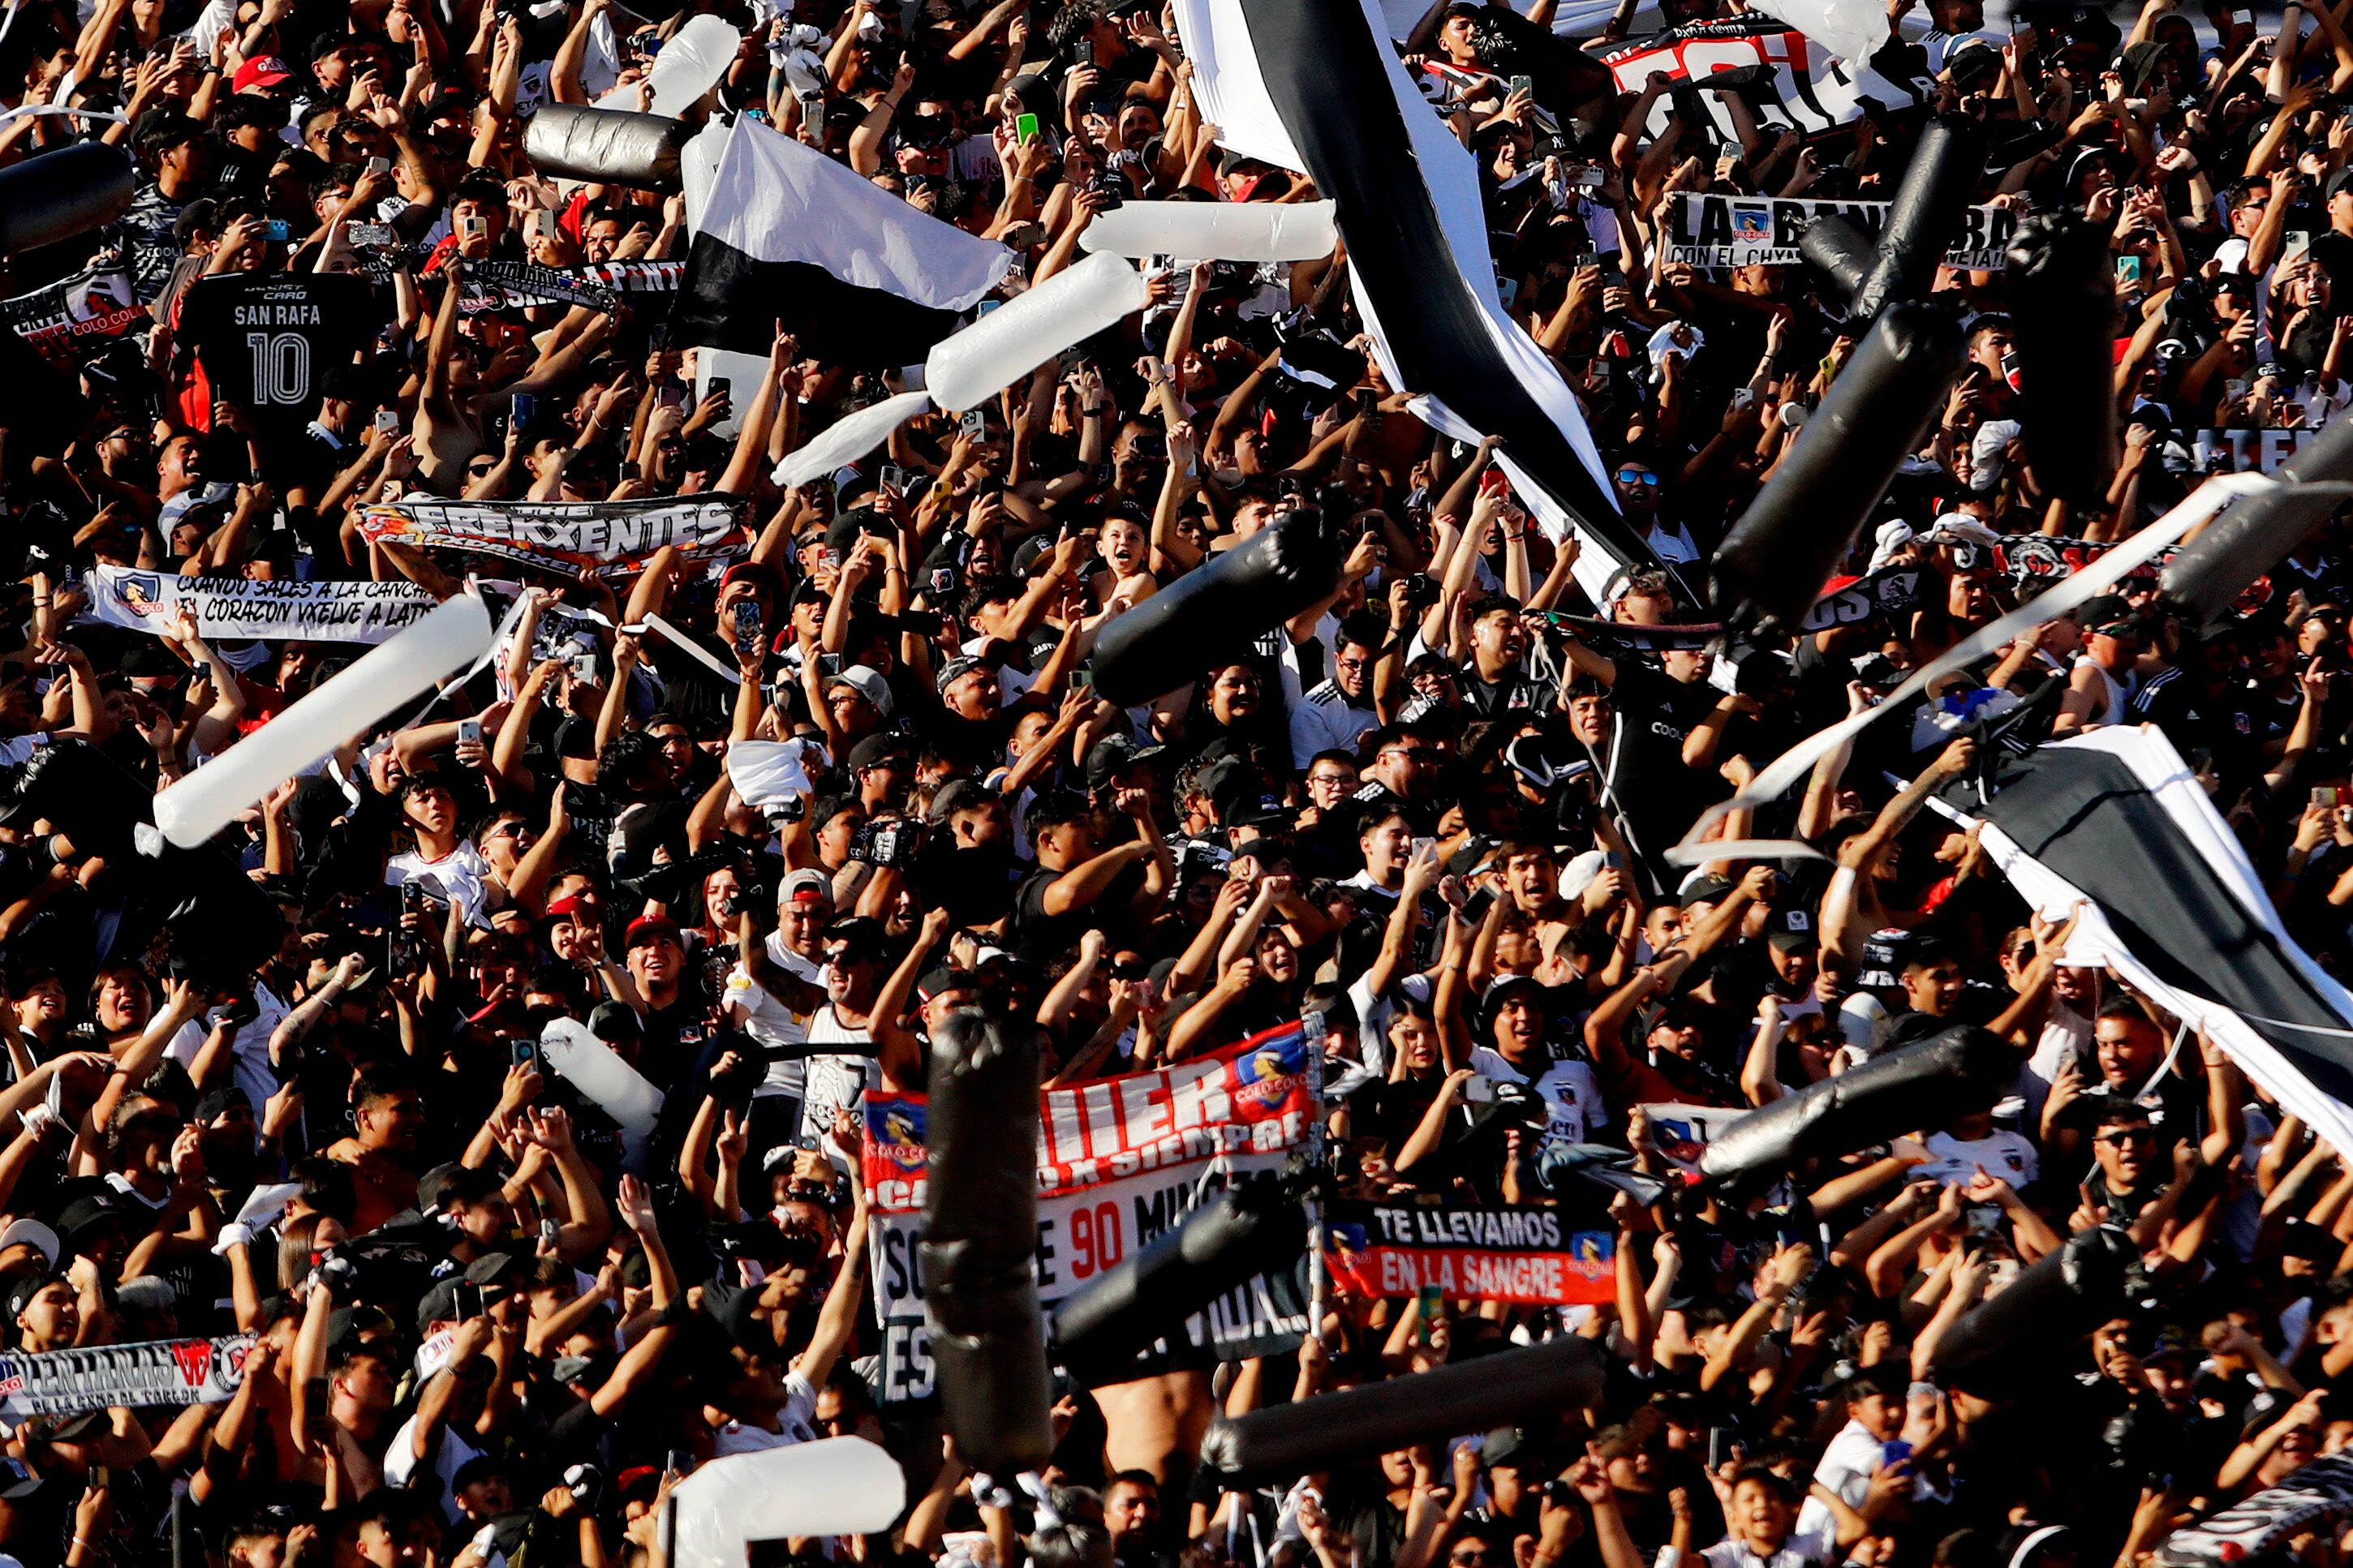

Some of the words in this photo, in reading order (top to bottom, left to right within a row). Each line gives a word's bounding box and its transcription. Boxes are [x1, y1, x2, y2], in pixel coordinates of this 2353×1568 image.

[1672, 195, 1733, 247] LA
[1671, 246, 1711, 266] CON
[1717, 247, 1739, 266] EL
[73, 316, 108, 337] COLO
[110, 303, 147, 322] COLO
[234, 305, 270, 325] SAN
[276, 305, 320, 325] RAFA
[247, 332, 310, 405] 10
[253, 580, 312, 599] SALES
[316, 582, 331, 599] A
[334, 582, 360, 599] LA
[204, 598, 294, 624] CORAZON
[366, 602, 381, 625] A
[1070, 1200, 1123, 1280] 90
[1374, 1206, 1413, 1243] TE
[1417, 1210, 1562, 1248] LLEVAMOS
[1382, 1251, 1417, 1291] EN
[1423, 1253, 1456, 1293] LA
[1462, 1254, 1563, 1299] SANGRE
